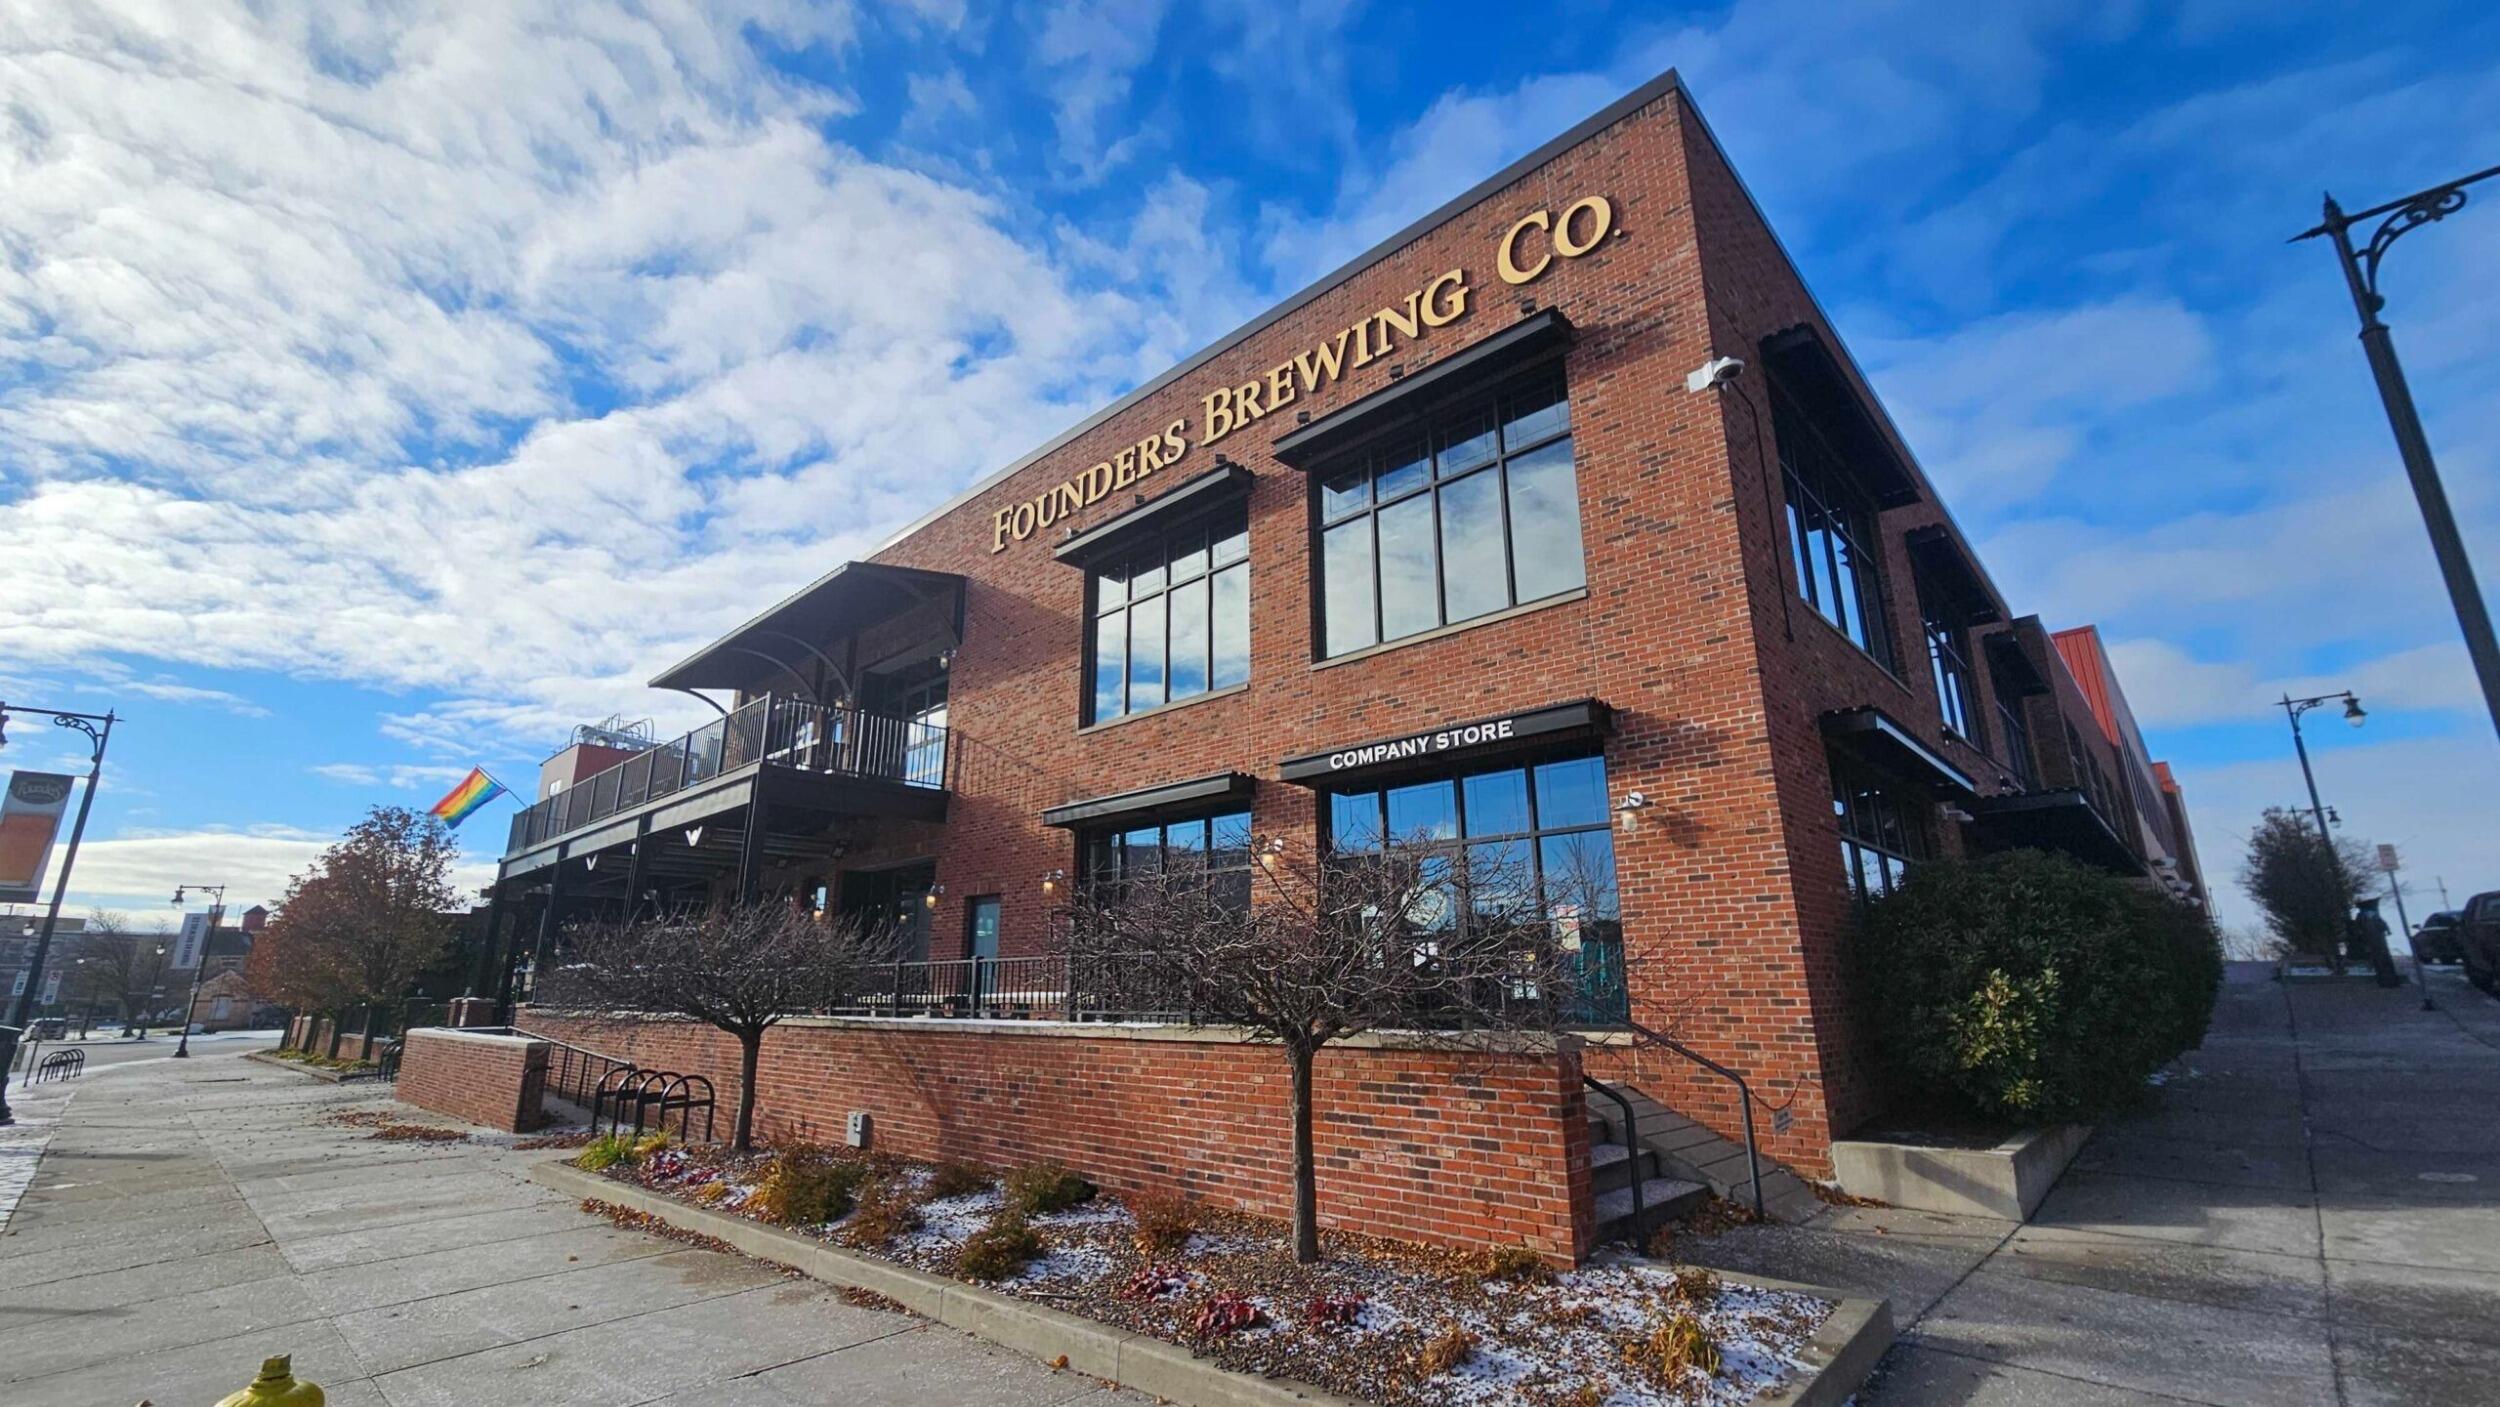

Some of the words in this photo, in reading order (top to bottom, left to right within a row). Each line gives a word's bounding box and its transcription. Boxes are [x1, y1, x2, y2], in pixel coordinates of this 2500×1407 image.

[990, 418, 1188, 556] FOUNDERS
[1200, 267, 1470, 447] BREWING
[1496, 194, 1623, 285] CO.
[1329, 734, 1431, 771] COMPANY
[1435, 719, 1514, 751] STORE
